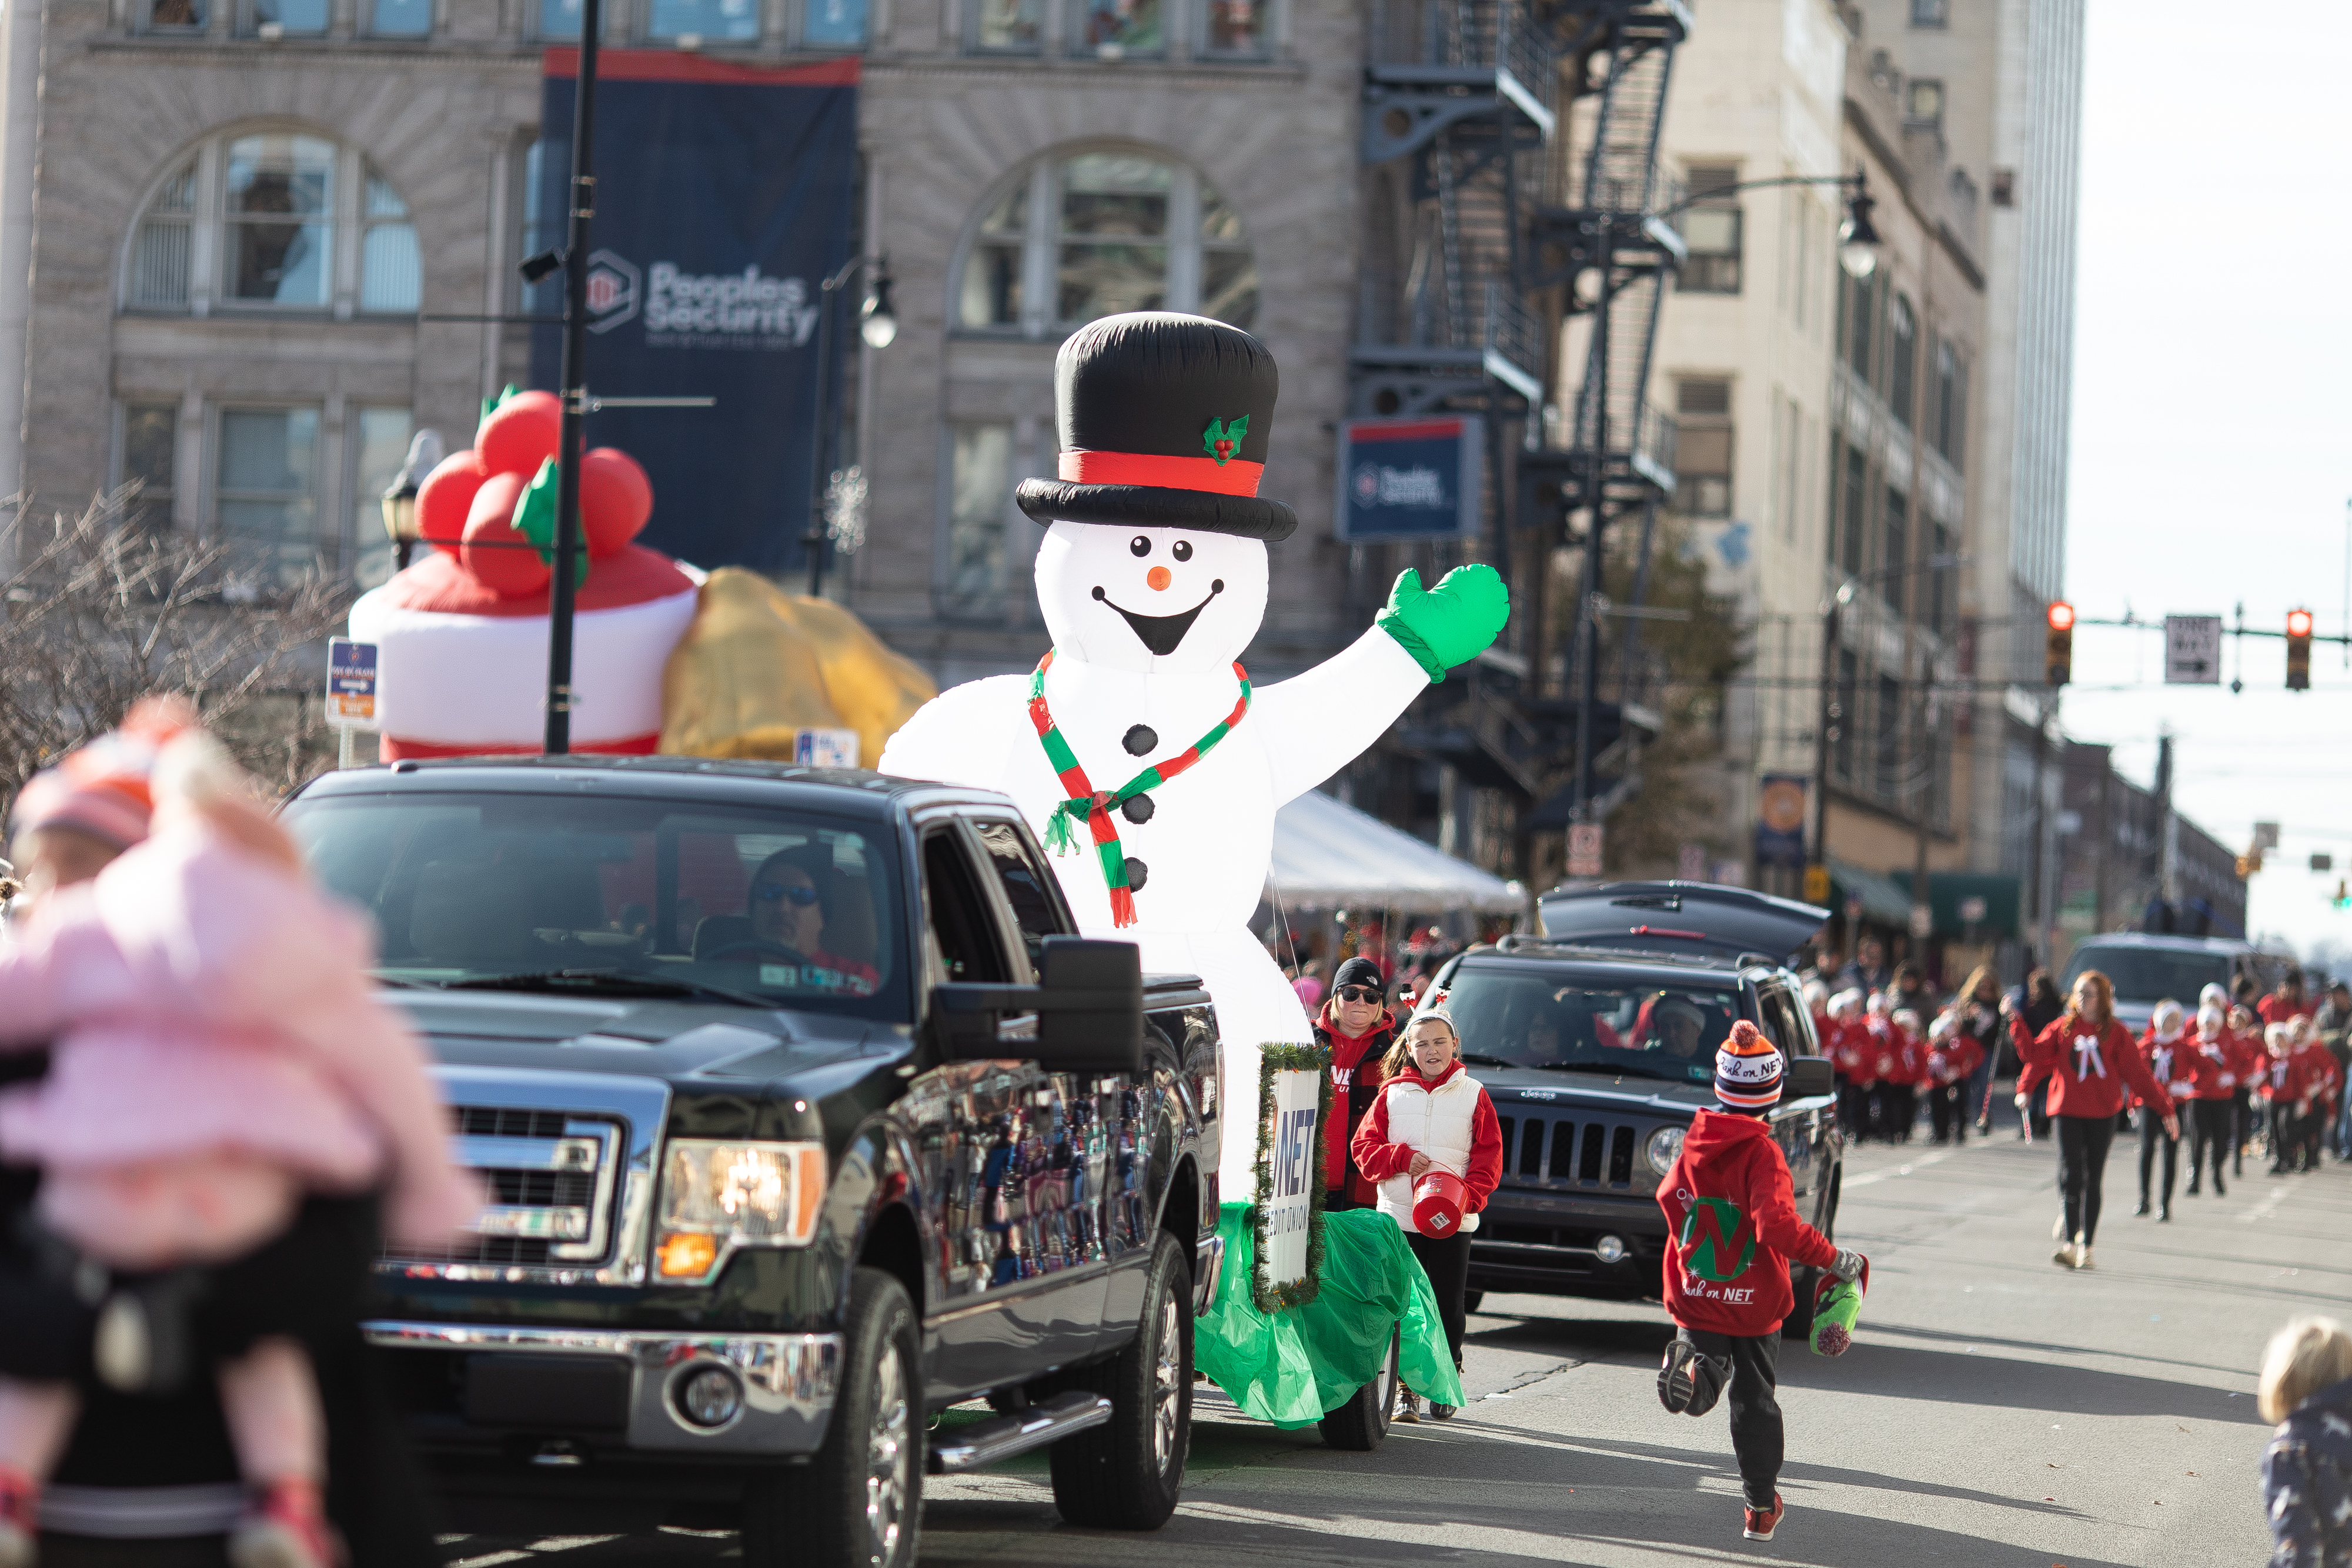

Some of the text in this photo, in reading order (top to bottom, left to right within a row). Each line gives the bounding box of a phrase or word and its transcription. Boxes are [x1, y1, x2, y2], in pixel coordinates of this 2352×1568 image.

[649, 261, 807, 307] Peoples
[646, 296, 820, 346] Security
[1760, 1058, 1782, 1076] NET
[1277, 1108, 1315, 1198] NET
[1287, 1203, 1308, 1233] UNION
[1706, 1289, 1720, 1299] on
[1723, 1288, 1754, 1302] NET
